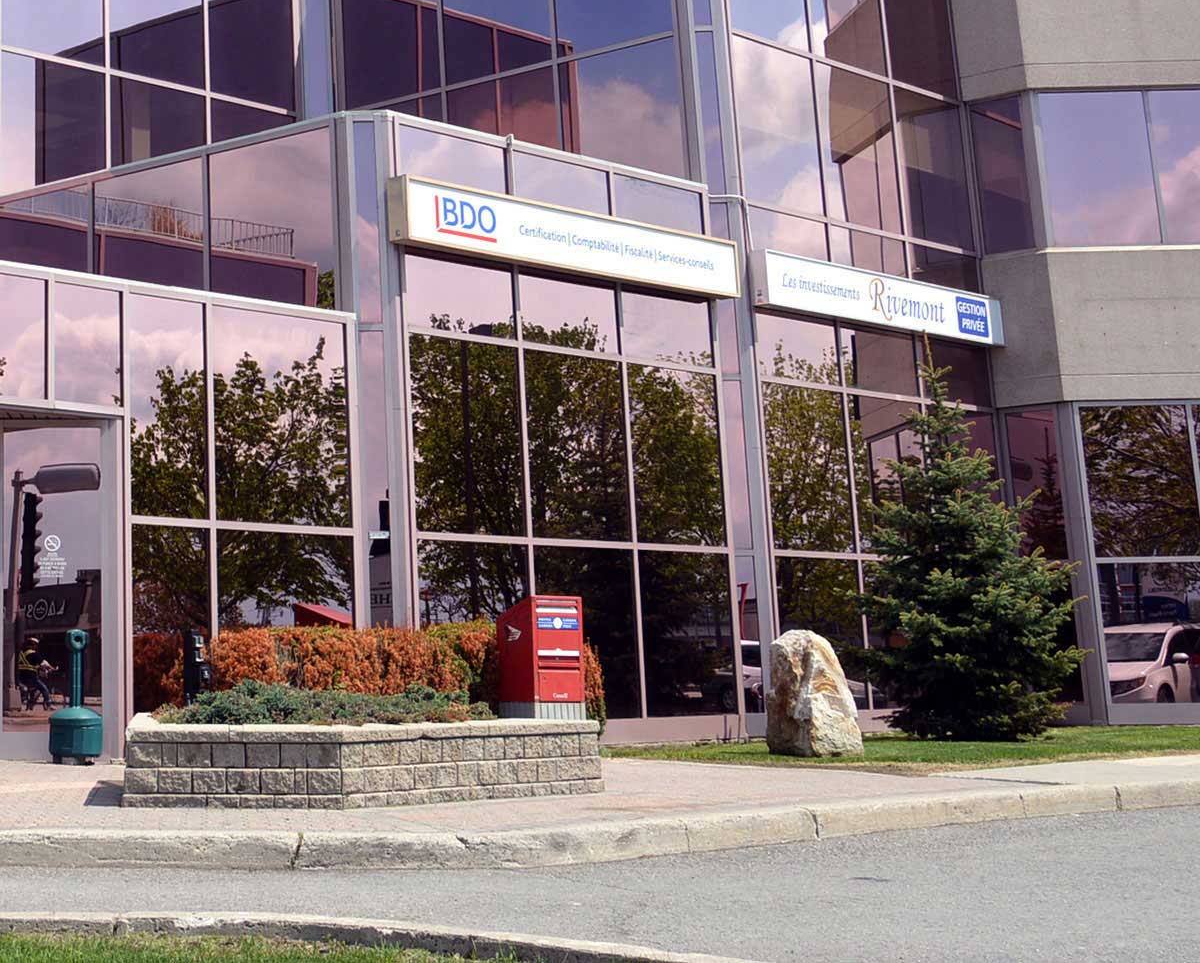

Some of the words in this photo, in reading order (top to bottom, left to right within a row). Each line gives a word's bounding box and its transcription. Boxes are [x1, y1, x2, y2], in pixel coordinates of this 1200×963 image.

[443, 196, 496, 233] BDO
[519, 225, 567, 243] Certification
[869, 277, 946, 323] Rivemont
[957, 300, 986, 317] GESTION
[961, 316, 986, 334] PRIVÉE
